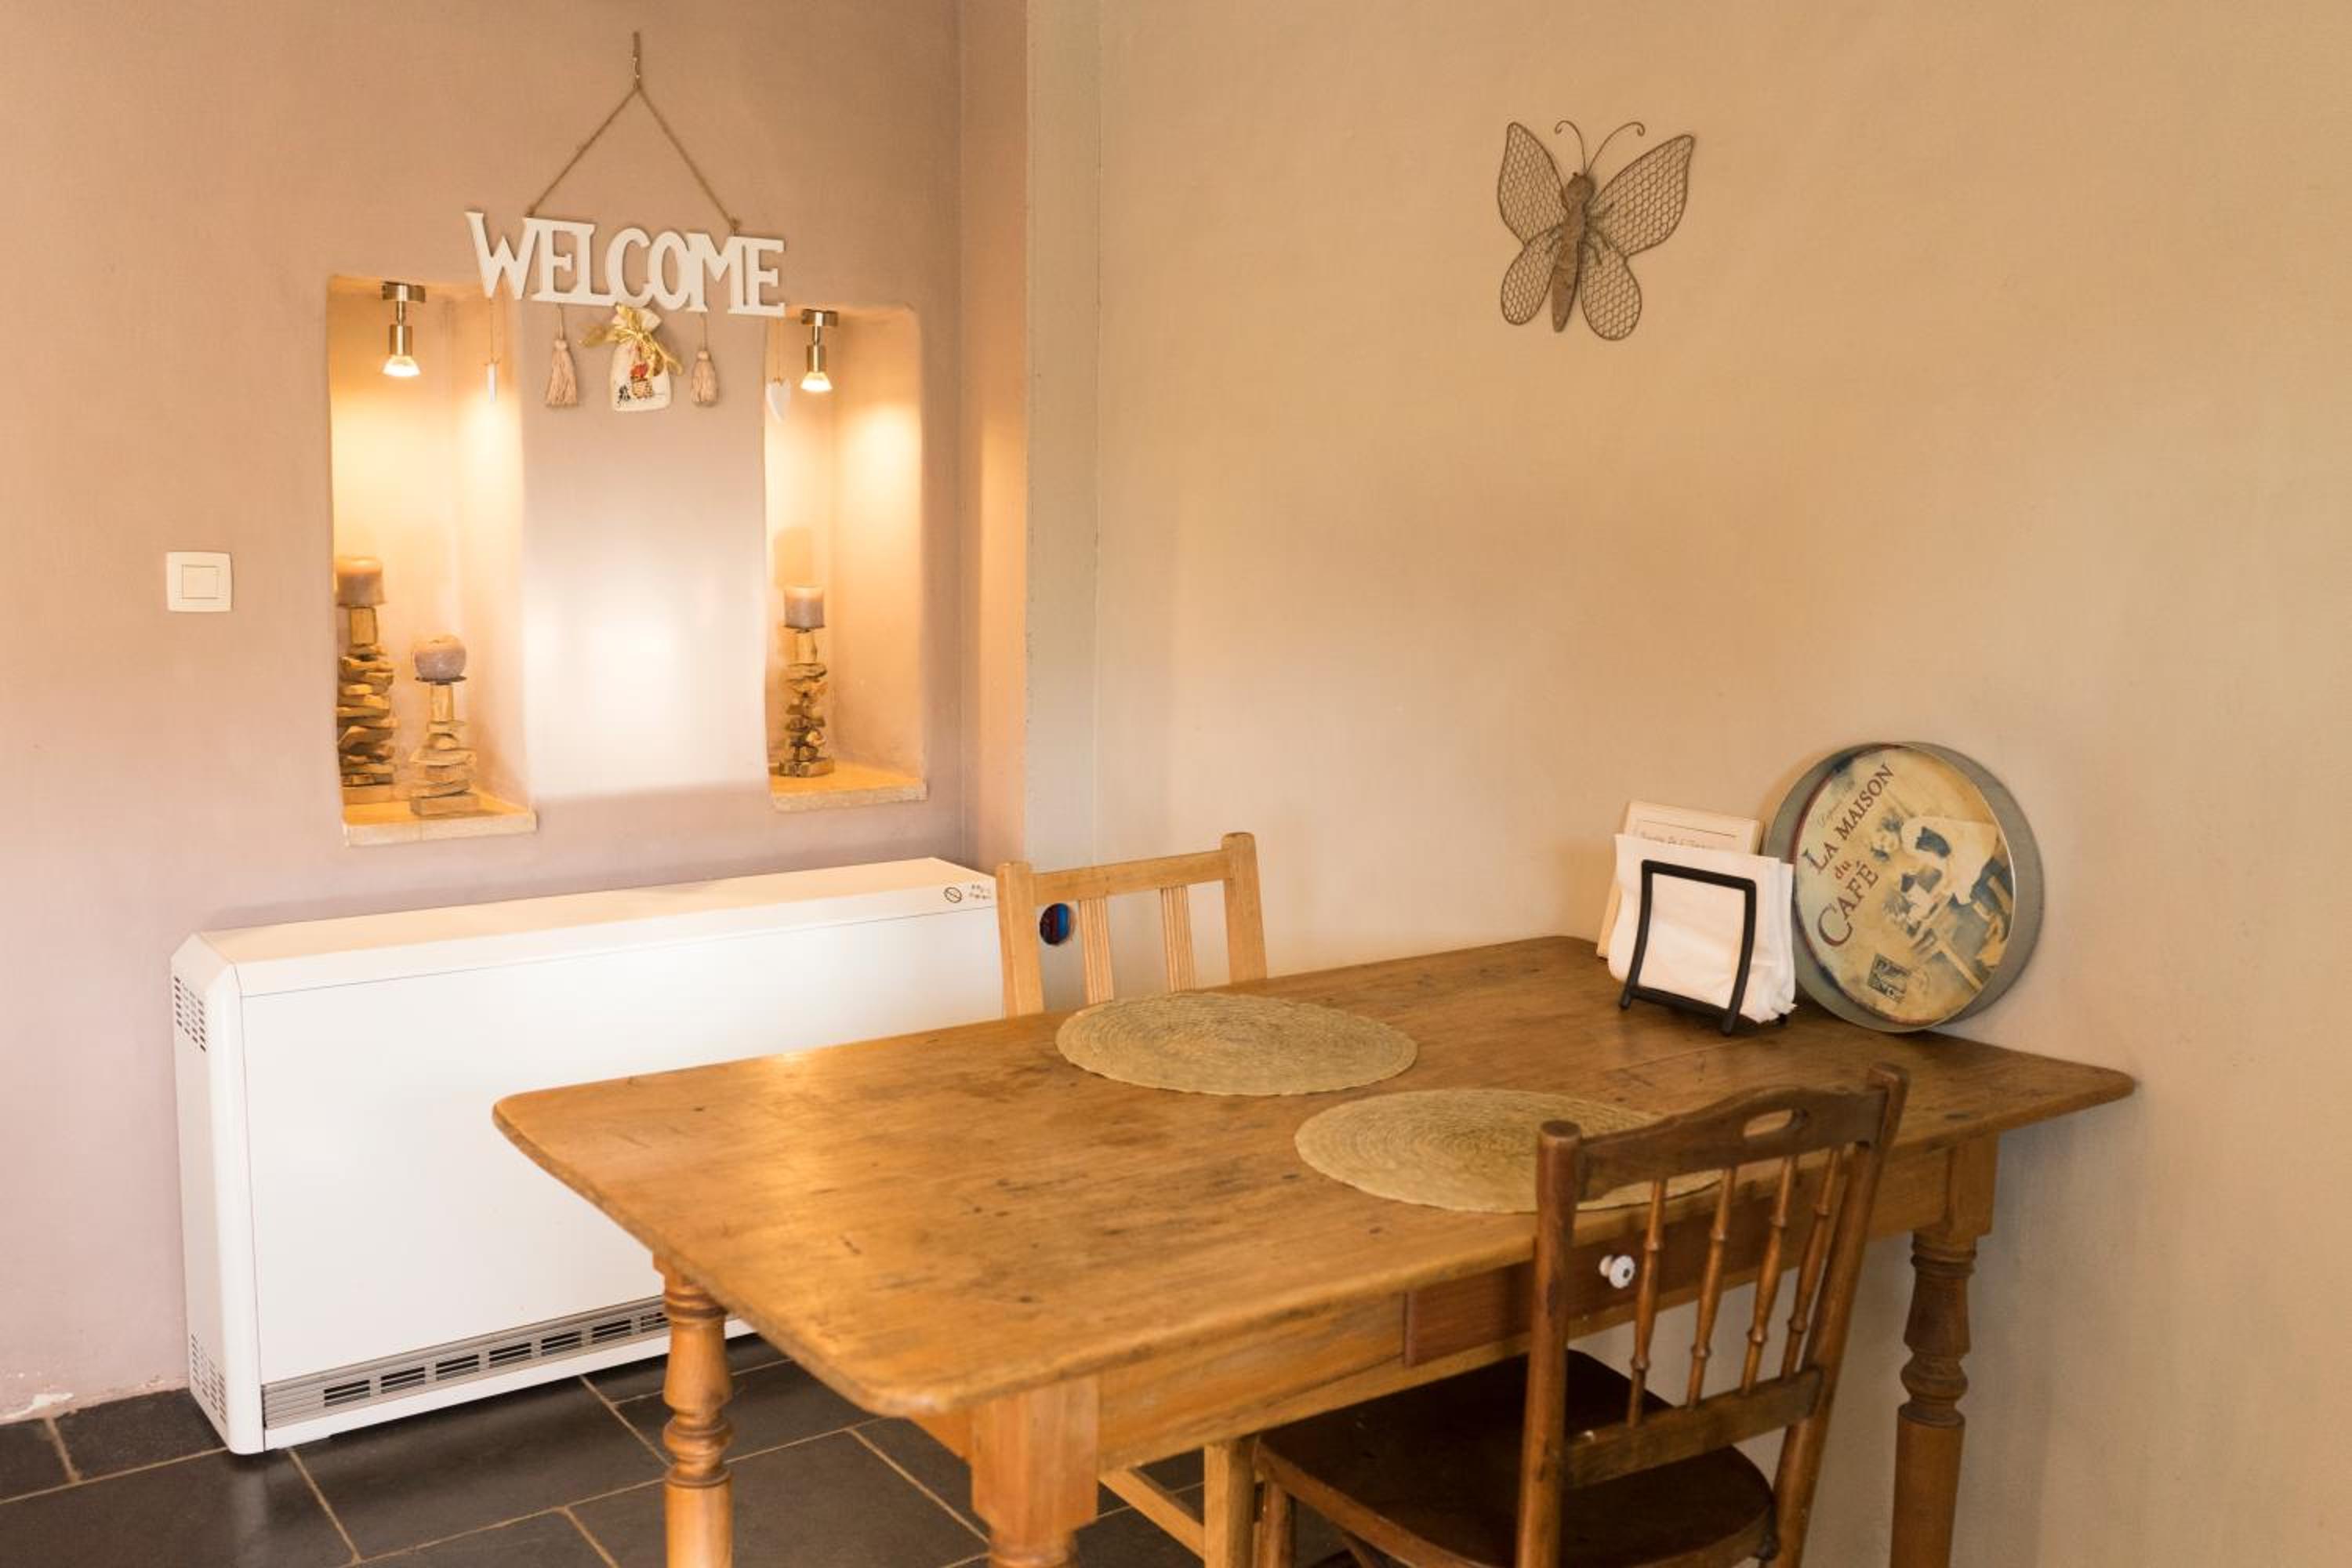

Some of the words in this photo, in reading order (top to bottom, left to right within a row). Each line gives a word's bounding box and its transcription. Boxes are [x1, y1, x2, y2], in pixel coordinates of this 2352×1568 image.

[465, 211, 785, 316] WELCOME
[1802, 842, 1838, 873] LA
[1834, 764, 1894, 840] MAISON
[1818, 860, 1879, 946] CAFÉ
[1835, 861, 1851, 879] du
